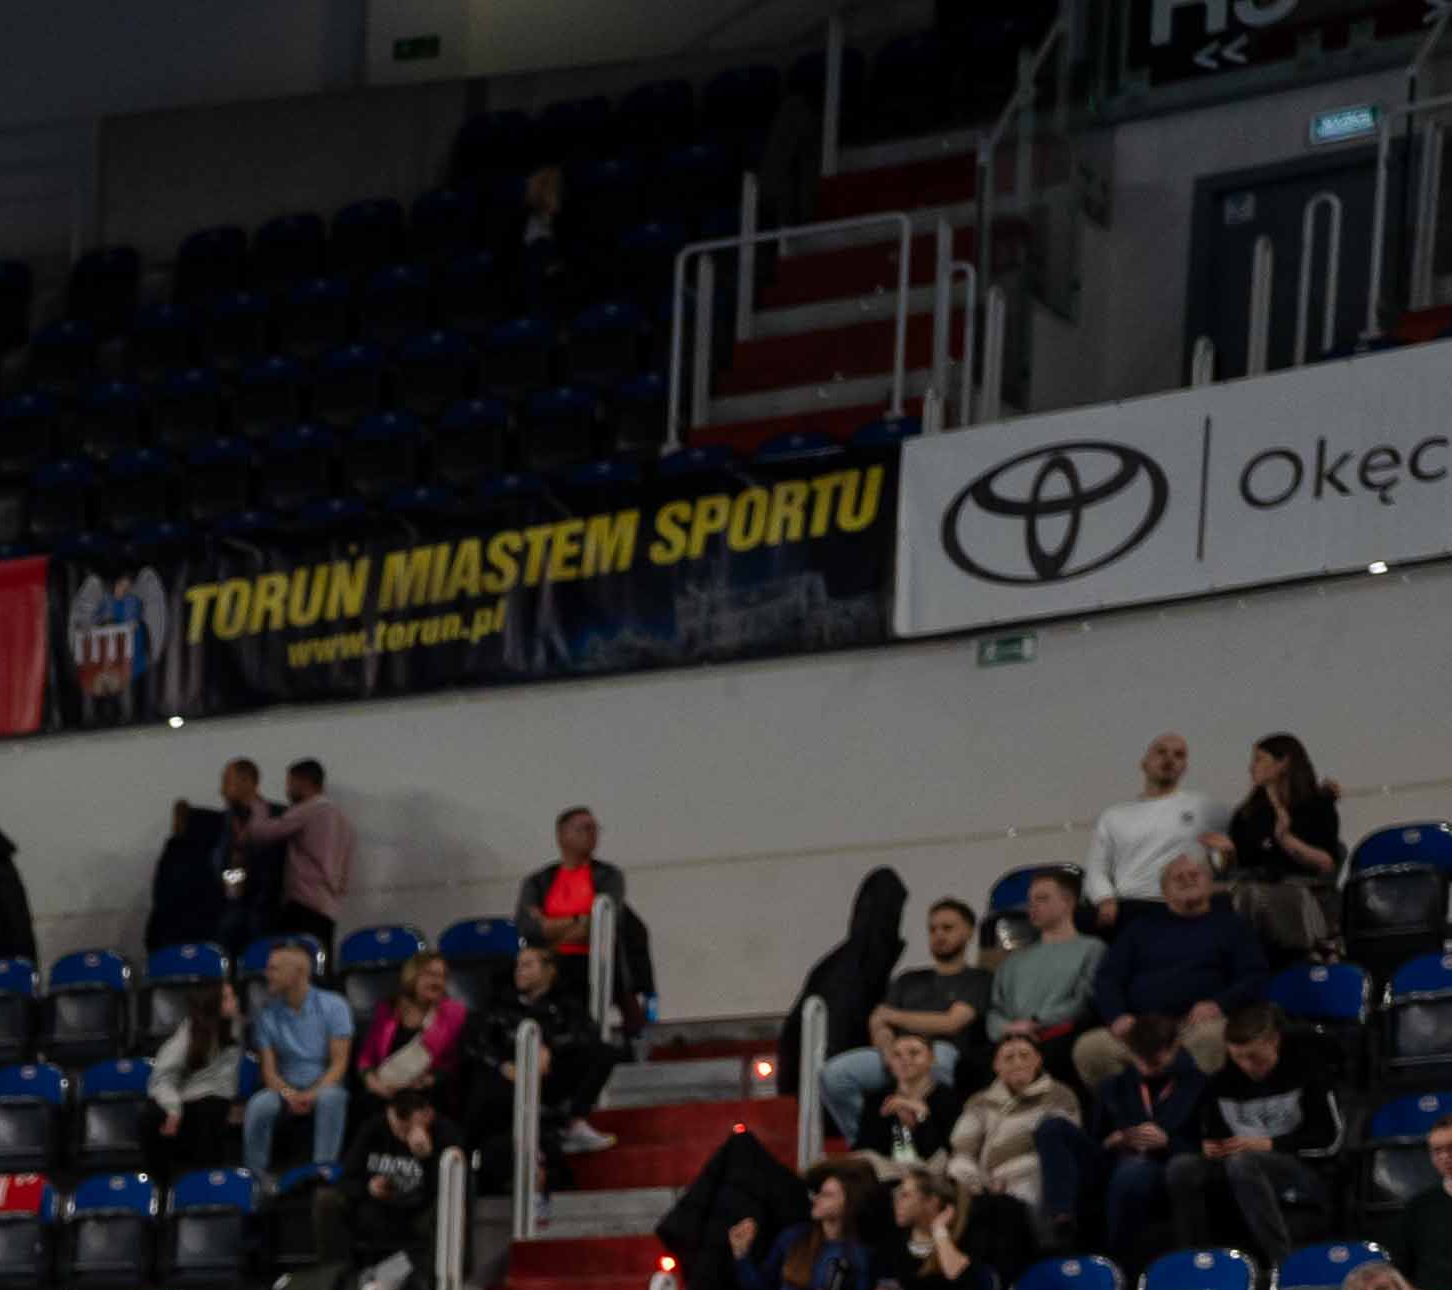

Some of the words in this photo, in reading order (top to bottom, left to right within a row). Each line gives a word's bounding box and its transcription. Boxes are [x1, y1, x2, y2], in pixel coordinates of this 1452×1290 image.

[1240, 434, 1452, 508] Okęc
[185, 543, 369, 645] TORUŃ
[381, 508, 641, 604] MIASTEM
[649, 464, 884, 566] SPORTU
[287, 599, 507, 669] www.torun.pl
